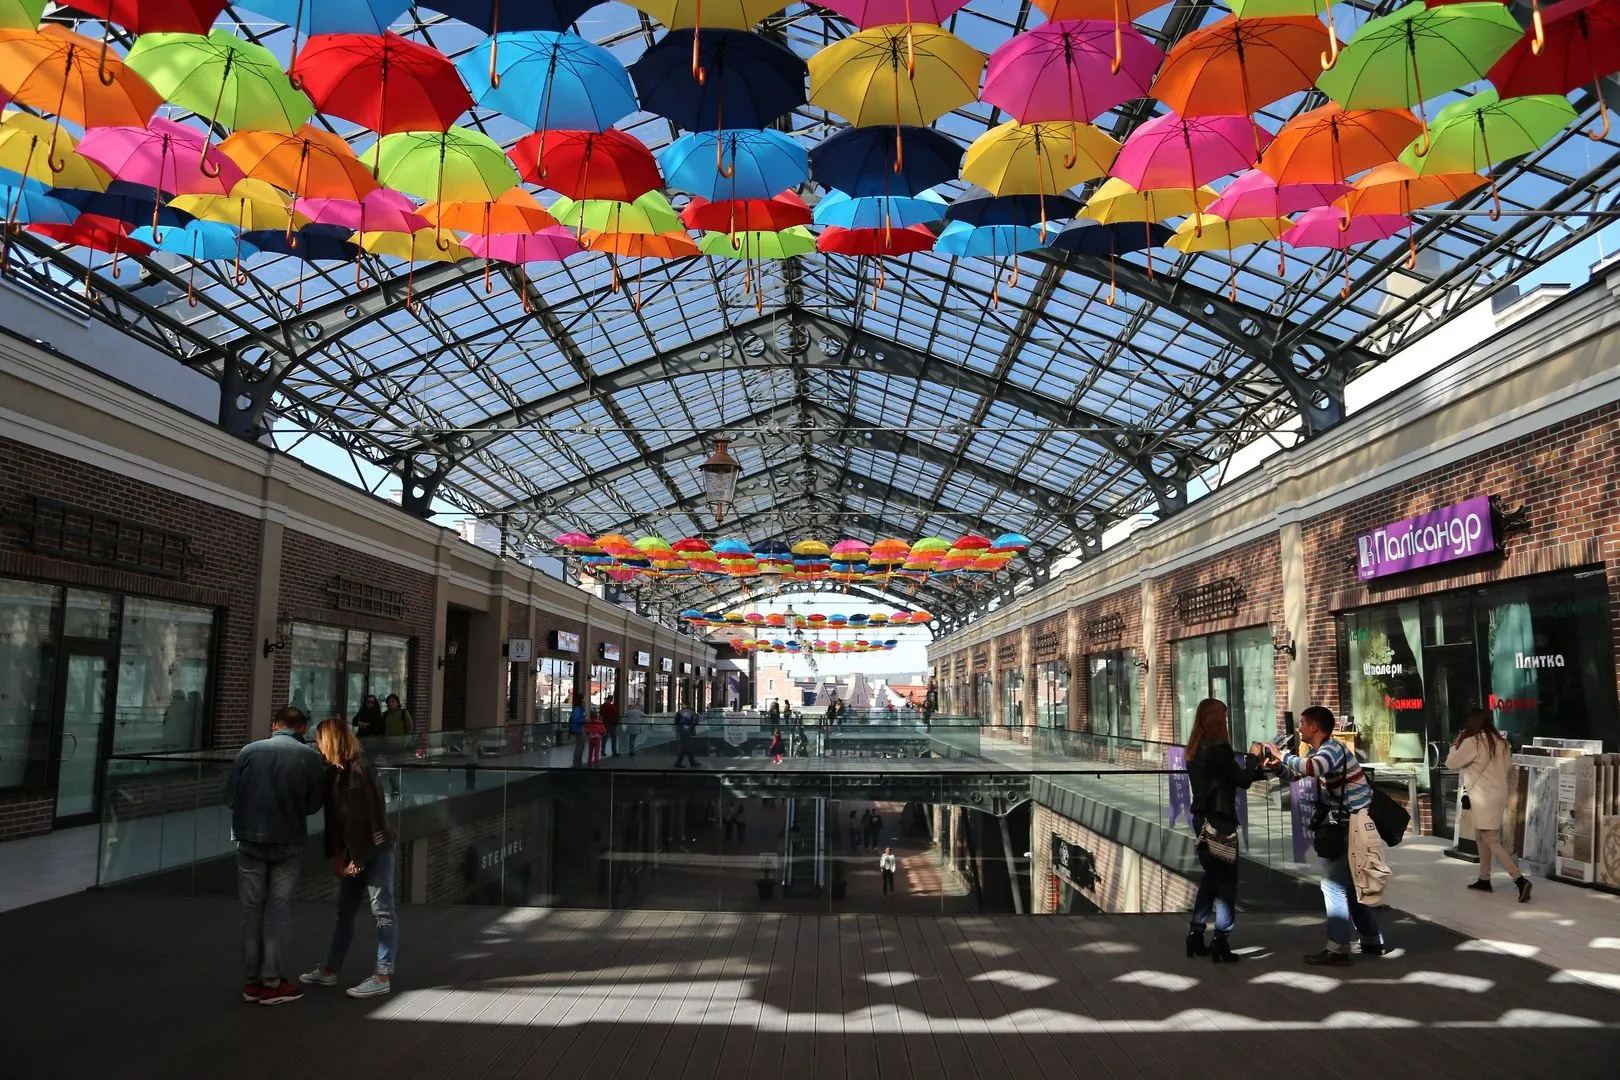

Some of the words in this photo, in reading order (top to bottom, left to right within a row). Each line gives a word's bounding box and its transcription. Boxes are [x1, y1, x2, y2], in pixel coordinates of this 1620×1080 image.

[1374, 513, 1481, 563] Палісандр
[1516, 653, 1565, 668] Плитка
[1363, 662, 1403, 678] Шпалери
